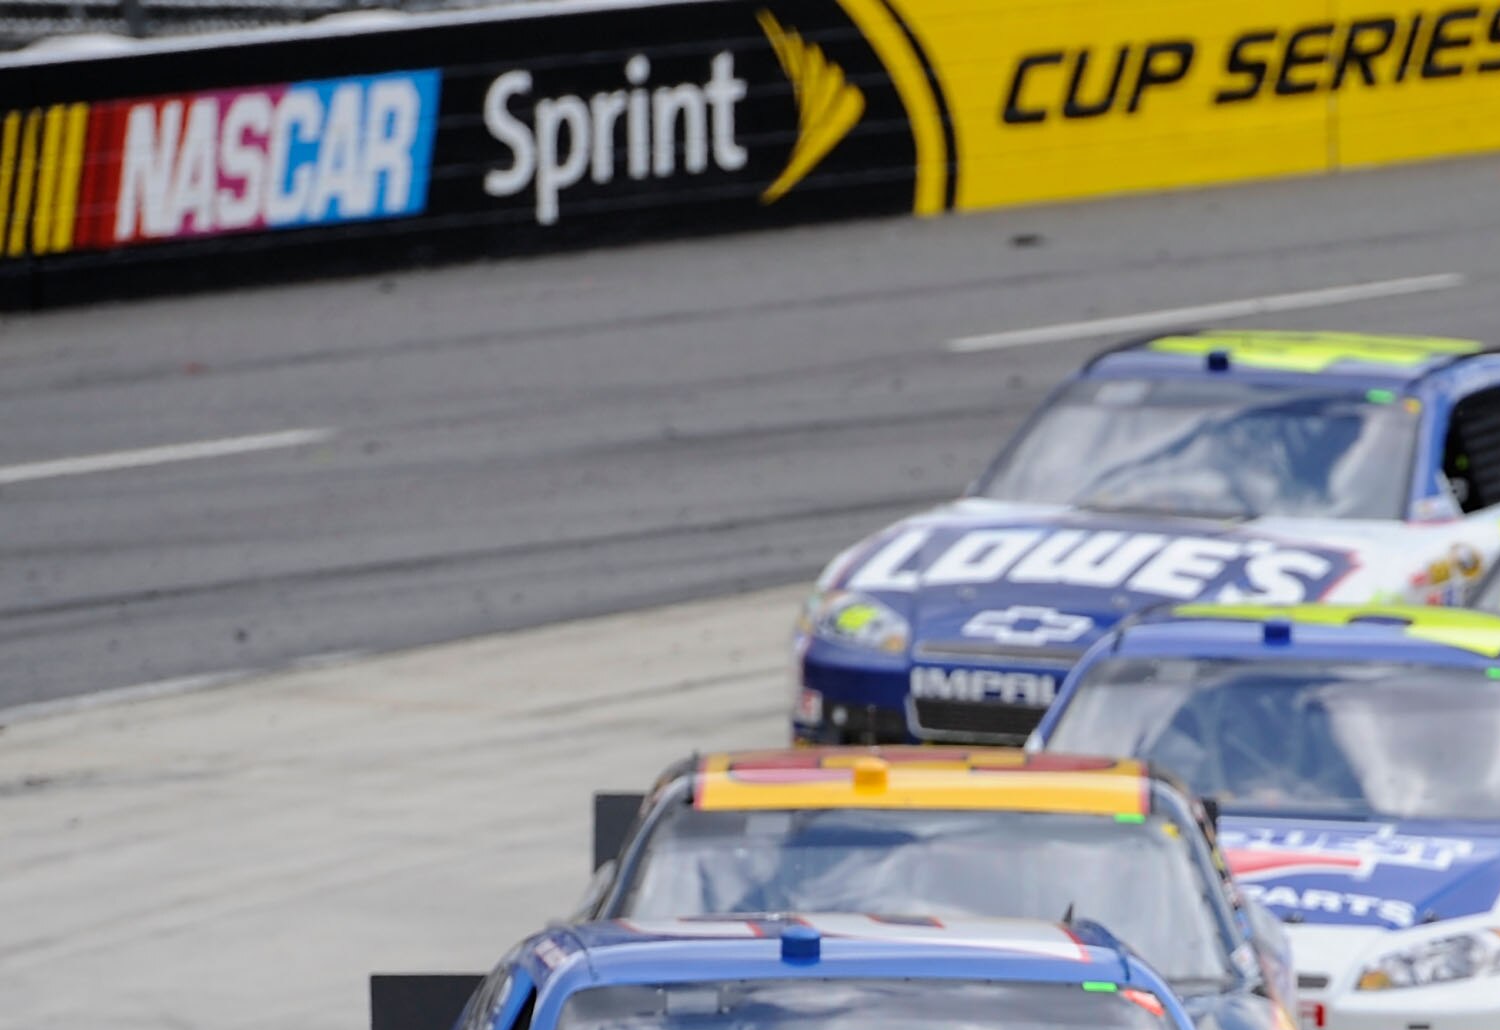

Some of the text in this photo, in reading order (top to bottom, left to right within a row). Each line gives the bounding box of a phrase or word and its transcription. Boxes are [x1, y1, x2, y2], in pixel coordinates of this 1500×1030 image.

[483, 50, 748, 225] Sprint
[1001, 39, 1196, 125] CUP
[113, 74, 421, 243] NASCAR
[848, 526, 1333, 604] LOWE'S
